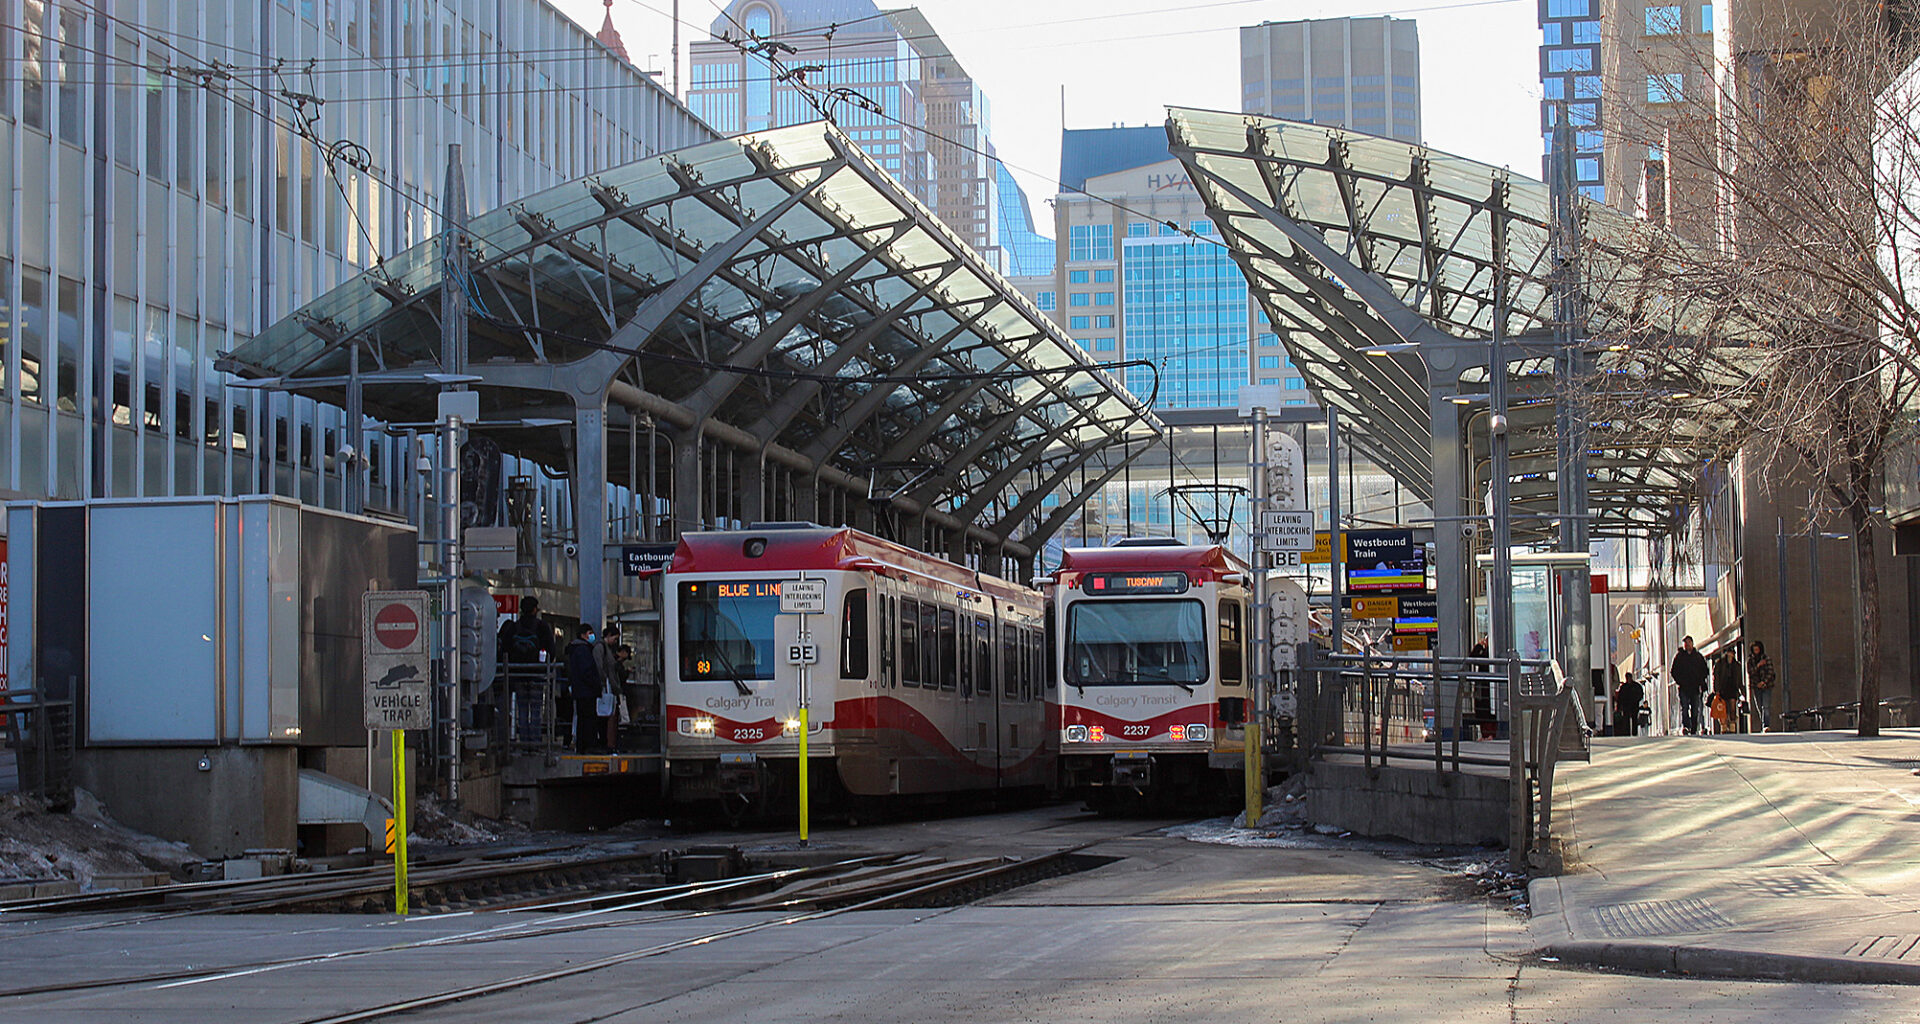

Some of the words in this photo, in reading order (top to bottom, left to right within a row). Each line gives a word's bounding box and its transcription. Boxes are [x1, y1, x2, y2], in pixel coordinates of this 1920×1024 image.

[1273, 515, 1302, 524] LEAVING
[1264, 526, 1311, 535] INTERLOCKING
[1276, 538, 1299, 546] LIMITS
[1353, 537, 1406, 547] Westbound
[629, 552, 675, 561] Eastbound
[1353, 549, 1377, 558] Train
[1276, 552, 1298, 566] BE
[629, 563, 651, 571] Train
[1126, 577, 1164, 587] TUSCANY
[718, 584, 750, 597] BLUE
[792, 584, 814, 592] LEAVING
[784, 592, 822, 600] INTERLOCKING
[794, 601, 812, 609] LIMITS
[790, 646, 813, 660] BE
[697, 660, 710, 673] 83
[373, 695, 421, 708] VEHICLE
[706, 696, 751, 711] Calgary
[1096, 695, 1138, 707] Calgary
[1141, 695, 1178, 705] Transit
[382, 709, 412, 722] TRAP
[733, 728, 764, 739] 2325
[1123, 725, 1151, 735] 2237
